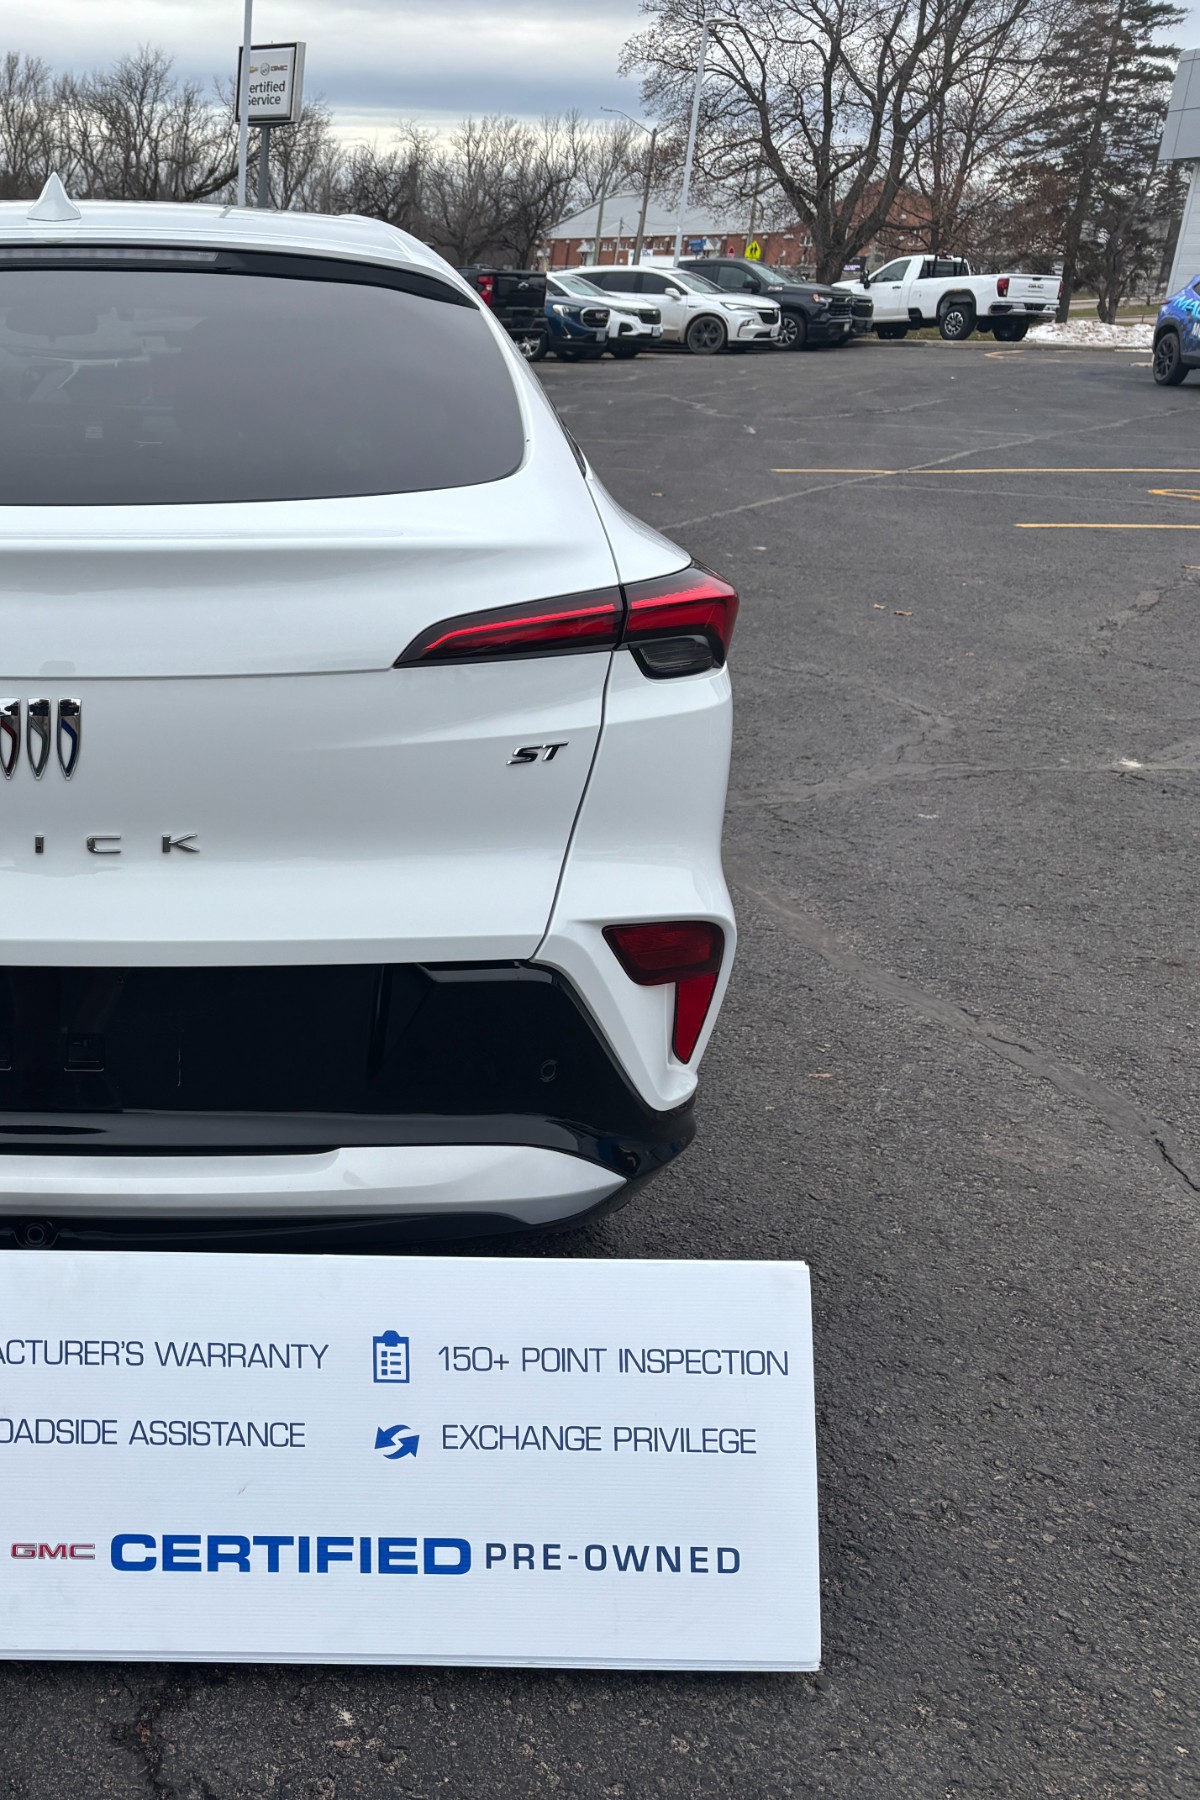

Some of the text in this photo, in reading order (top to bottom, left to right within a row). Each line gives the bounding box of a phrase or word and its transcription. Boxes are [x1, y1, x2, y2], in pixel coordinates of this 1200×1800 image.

[249, 80, 286, 93] ertified
[506, 741, 569, 765] ST
[154, 1341, 329, 1369] WARRANTY
[437, 1345, 789, 1376] 150+ POINT INSPECTION
[128, 1419, 306, 1448] ASSISTANCE
[441, 1424, 757, 1454] EXCHANGE PRIVILEGE
[10, 1533, 741, 1575] GMC CERTIFIED PRE-OWNED
